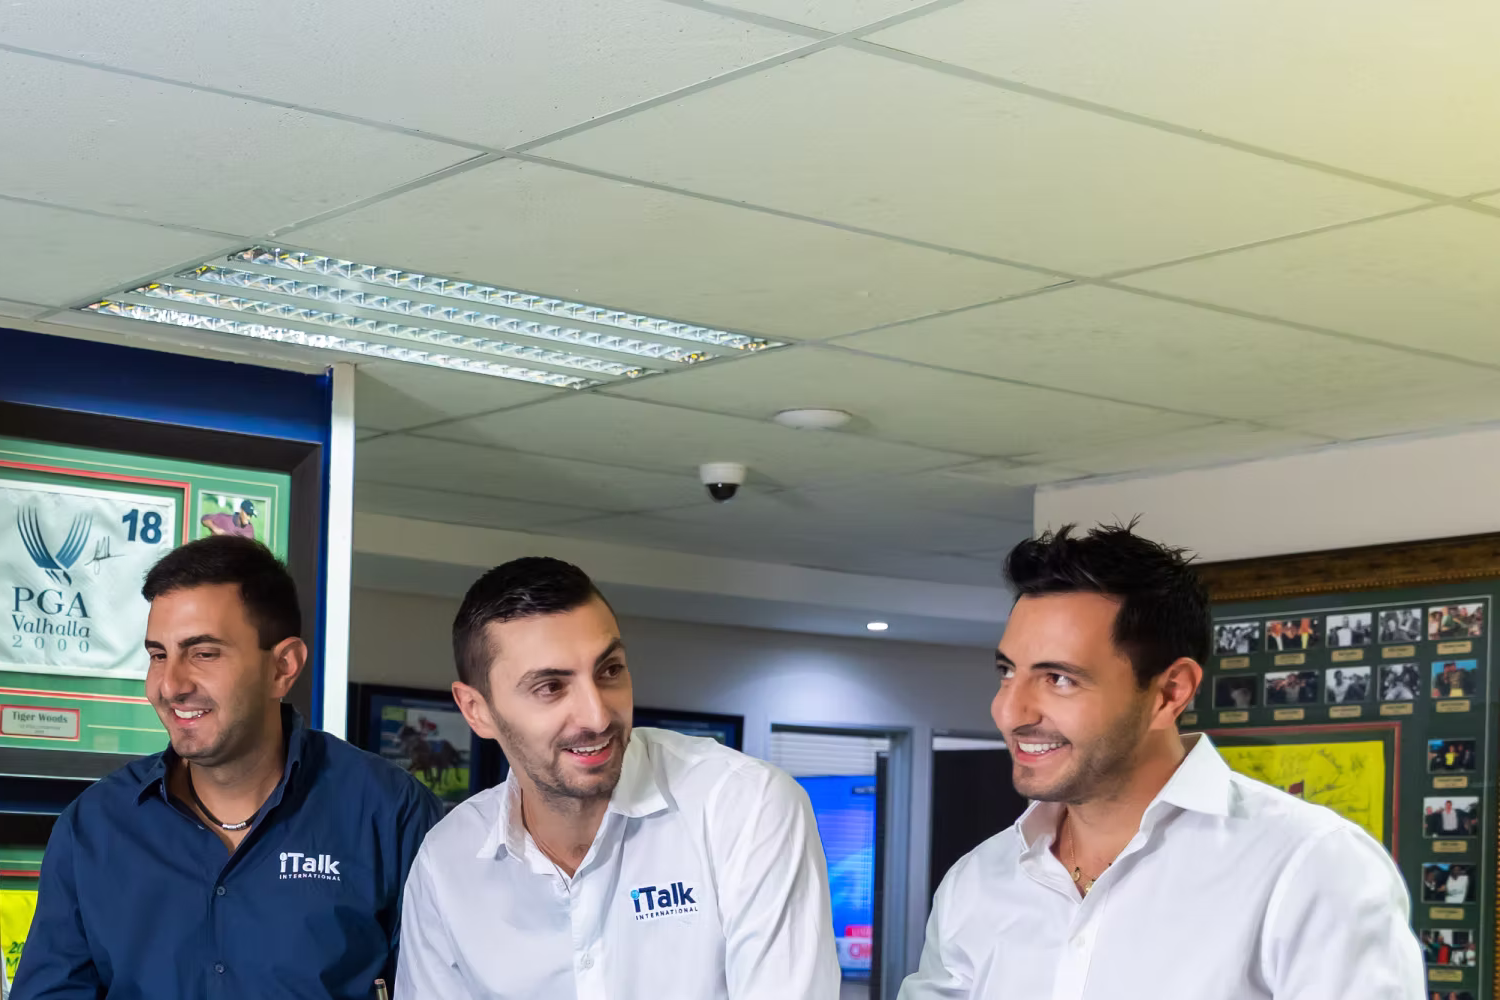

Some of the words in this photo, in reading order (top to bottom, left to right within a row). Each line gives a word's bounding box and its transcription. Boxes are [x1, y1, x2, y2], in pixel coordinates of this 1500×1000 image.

[122, 508, 163, 545] 18
[12, 586, 91, 618] PGA
[12, 614, 91, 638] Valhalla
[12, 634, 90, 653] 2000
[12, 711, 36, 722] Tiger
[38, 713, 68, 723] Woods
[279, 852, 340, 875] iTalk
[279, 873, 341, 881] INTERNATIONAL
[630, 882, 696, 912] iTalk
[636, 906, 698, 920] INTERNATIONAL
